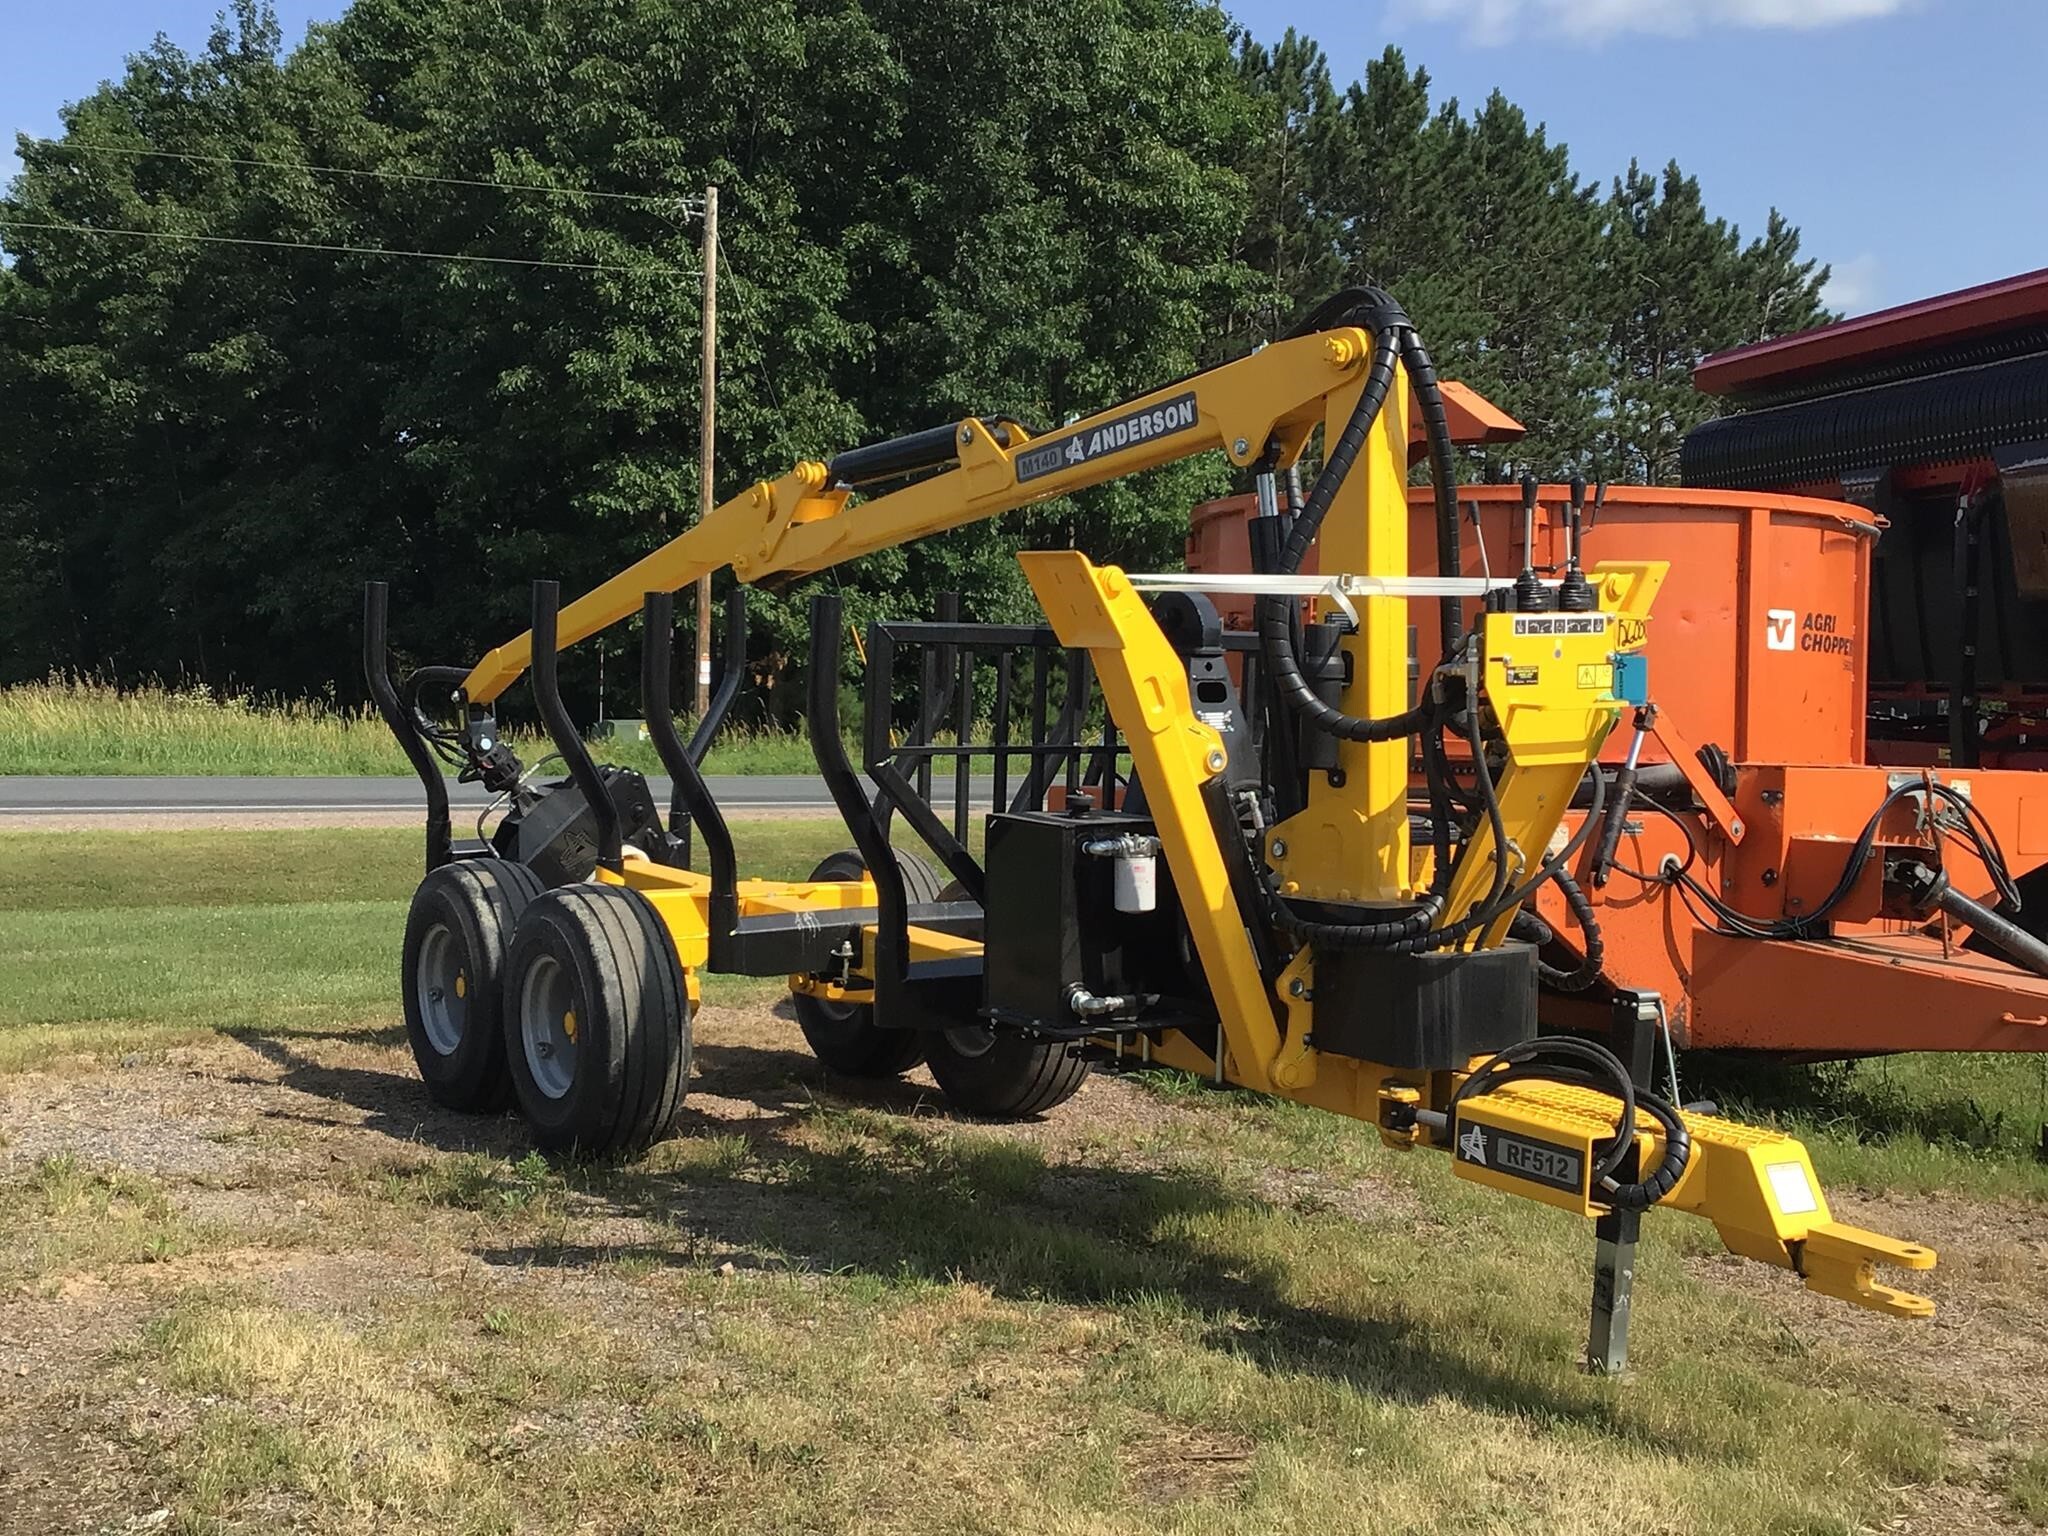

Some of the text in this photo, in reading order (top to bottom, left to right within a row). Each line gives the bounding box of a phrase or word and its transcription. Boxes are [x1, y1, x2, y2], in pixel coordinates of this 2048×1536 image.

[1021, 401, 1194, 476] M140 ANDERSON
[1802, 612, 1837, 634] AGRI
[1506, 1143, 1569, 1180] RF512
